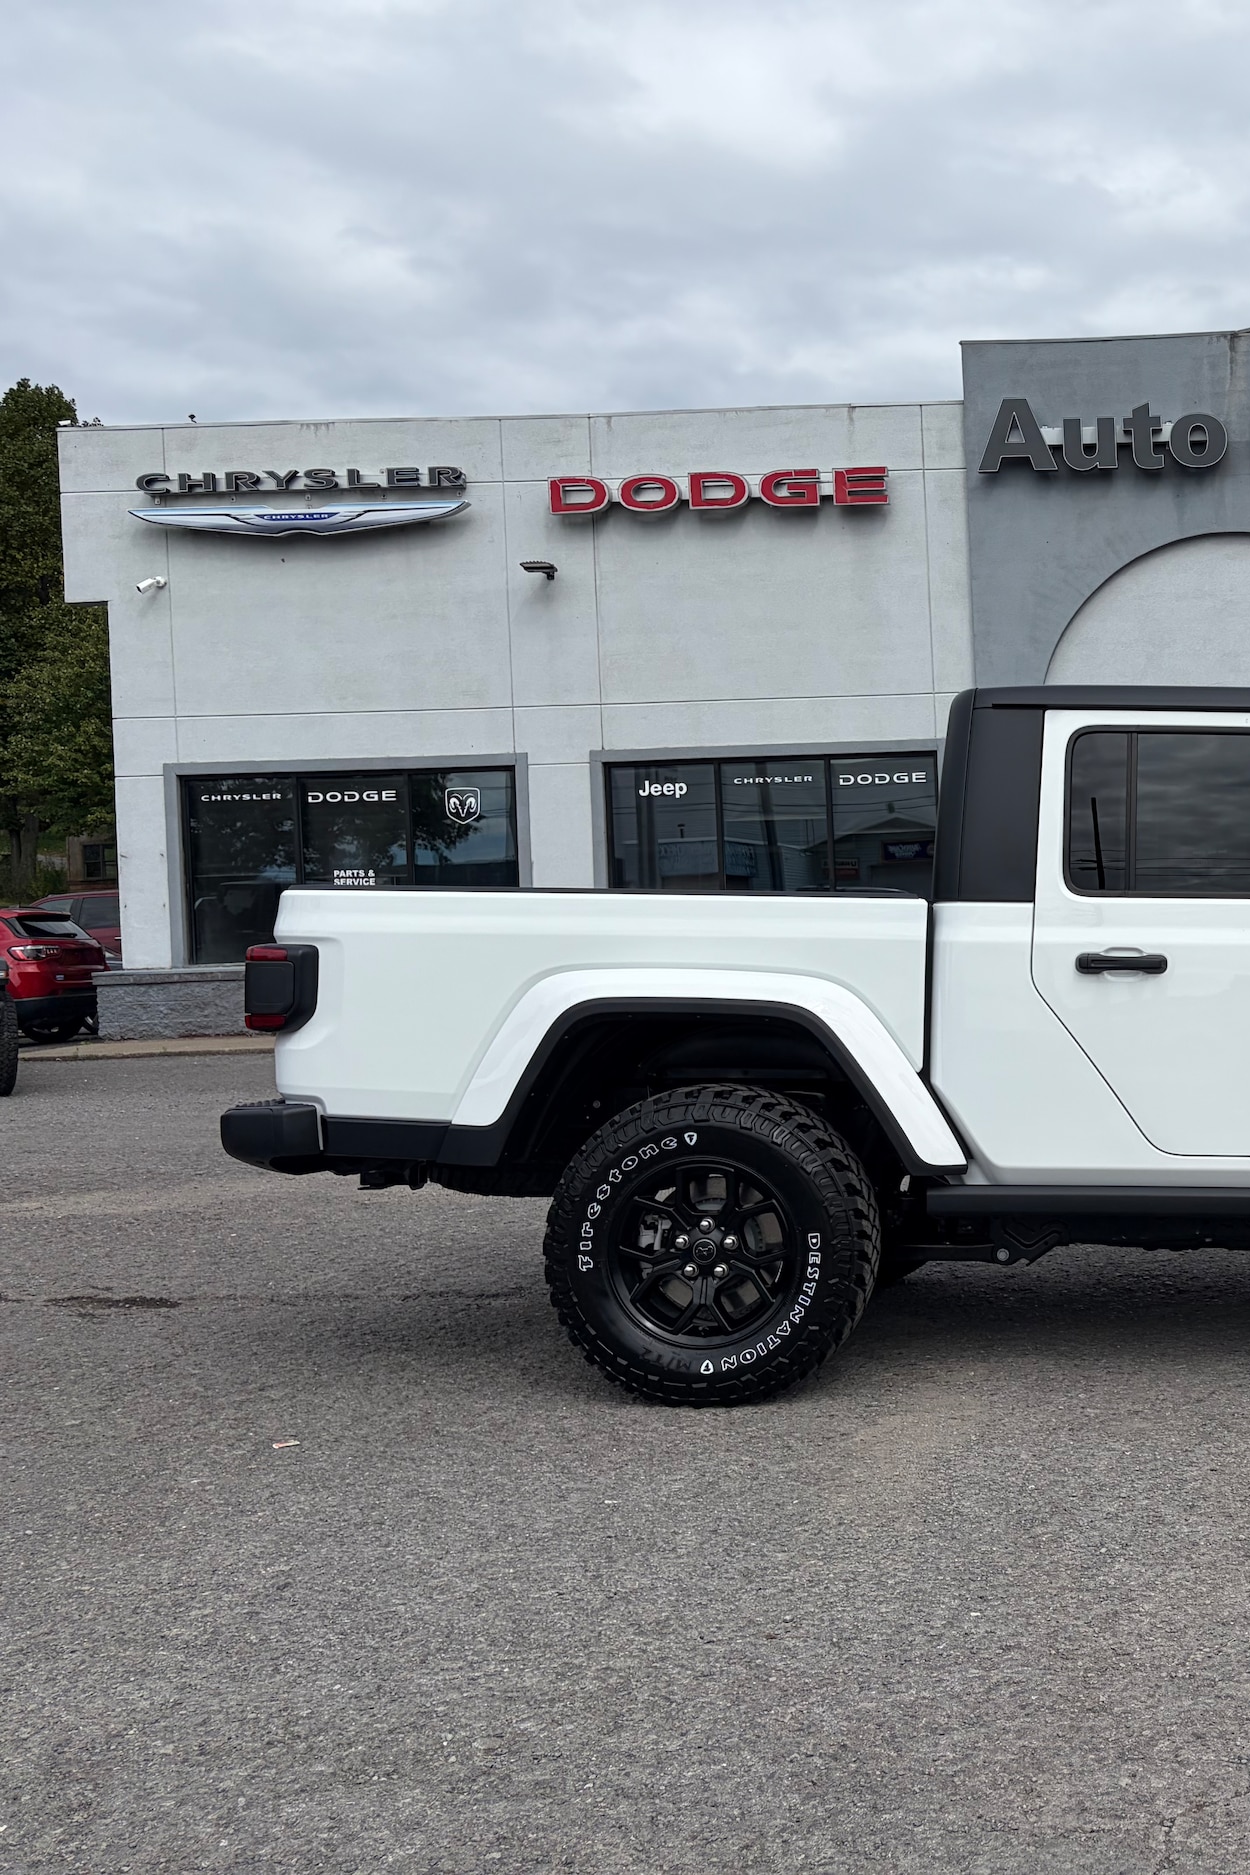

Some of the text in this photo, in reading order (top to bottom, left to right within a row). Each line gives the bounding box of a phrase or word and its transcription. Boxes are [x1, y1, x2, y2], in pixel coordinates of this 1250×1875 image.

[978, 397, 1229, 473] Auto
[136, 466, 466, 496] CHRYSLER
[548, 466, 889, 515] DODGE
[733, 775, 813, 785] CHRYSLER
[839, 771, 927, 786] DODGE
[307, 790, 397, 803] DODGE
[638, 780, 688, 799] Jeep
[200, 792, 282, 803] CHRYSLER
[333, 869, 376, 878] PARTS &
[333, 877, 376, 886] SERVICE
[720, 1231, 822, 1371] DESTINATION
